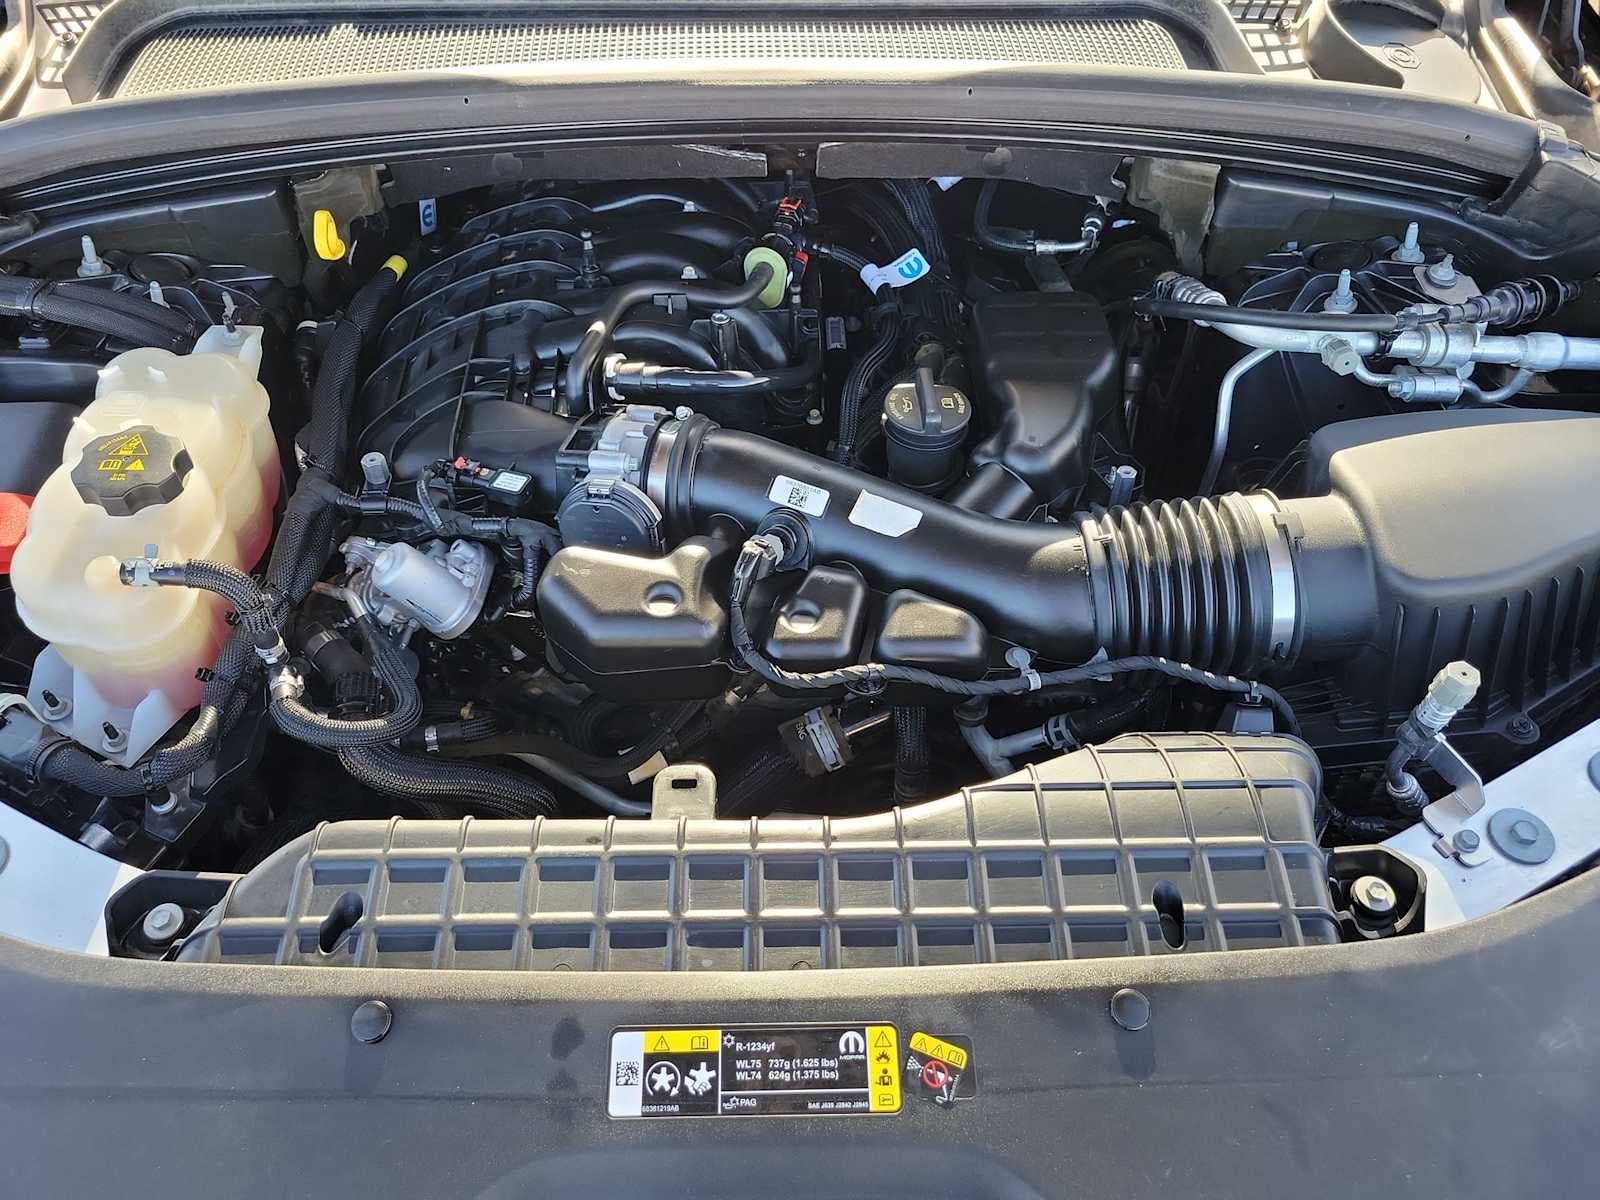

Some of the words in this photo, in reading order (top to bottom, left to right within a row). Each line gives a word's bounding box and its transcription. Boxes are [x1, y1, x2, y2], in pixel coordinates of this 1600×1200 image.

[735, 1041, 775, 1053] R-1234yf
[736, 1059, 762, 1069] WL75
[768, 1059, 790, 1070] 737g
[792, 1058, 820, 1069] (1.625
[821, 1058, 839, 1068] lbs)
[736, 1071, 762, 1081] WL74
[768, 1070, 791, 1082] 624g
[792, 1070, 820, 1080] (1.375
[821, 1069, 839, 1080] lbs)
[740, 1097, 757, 1107] PAG
